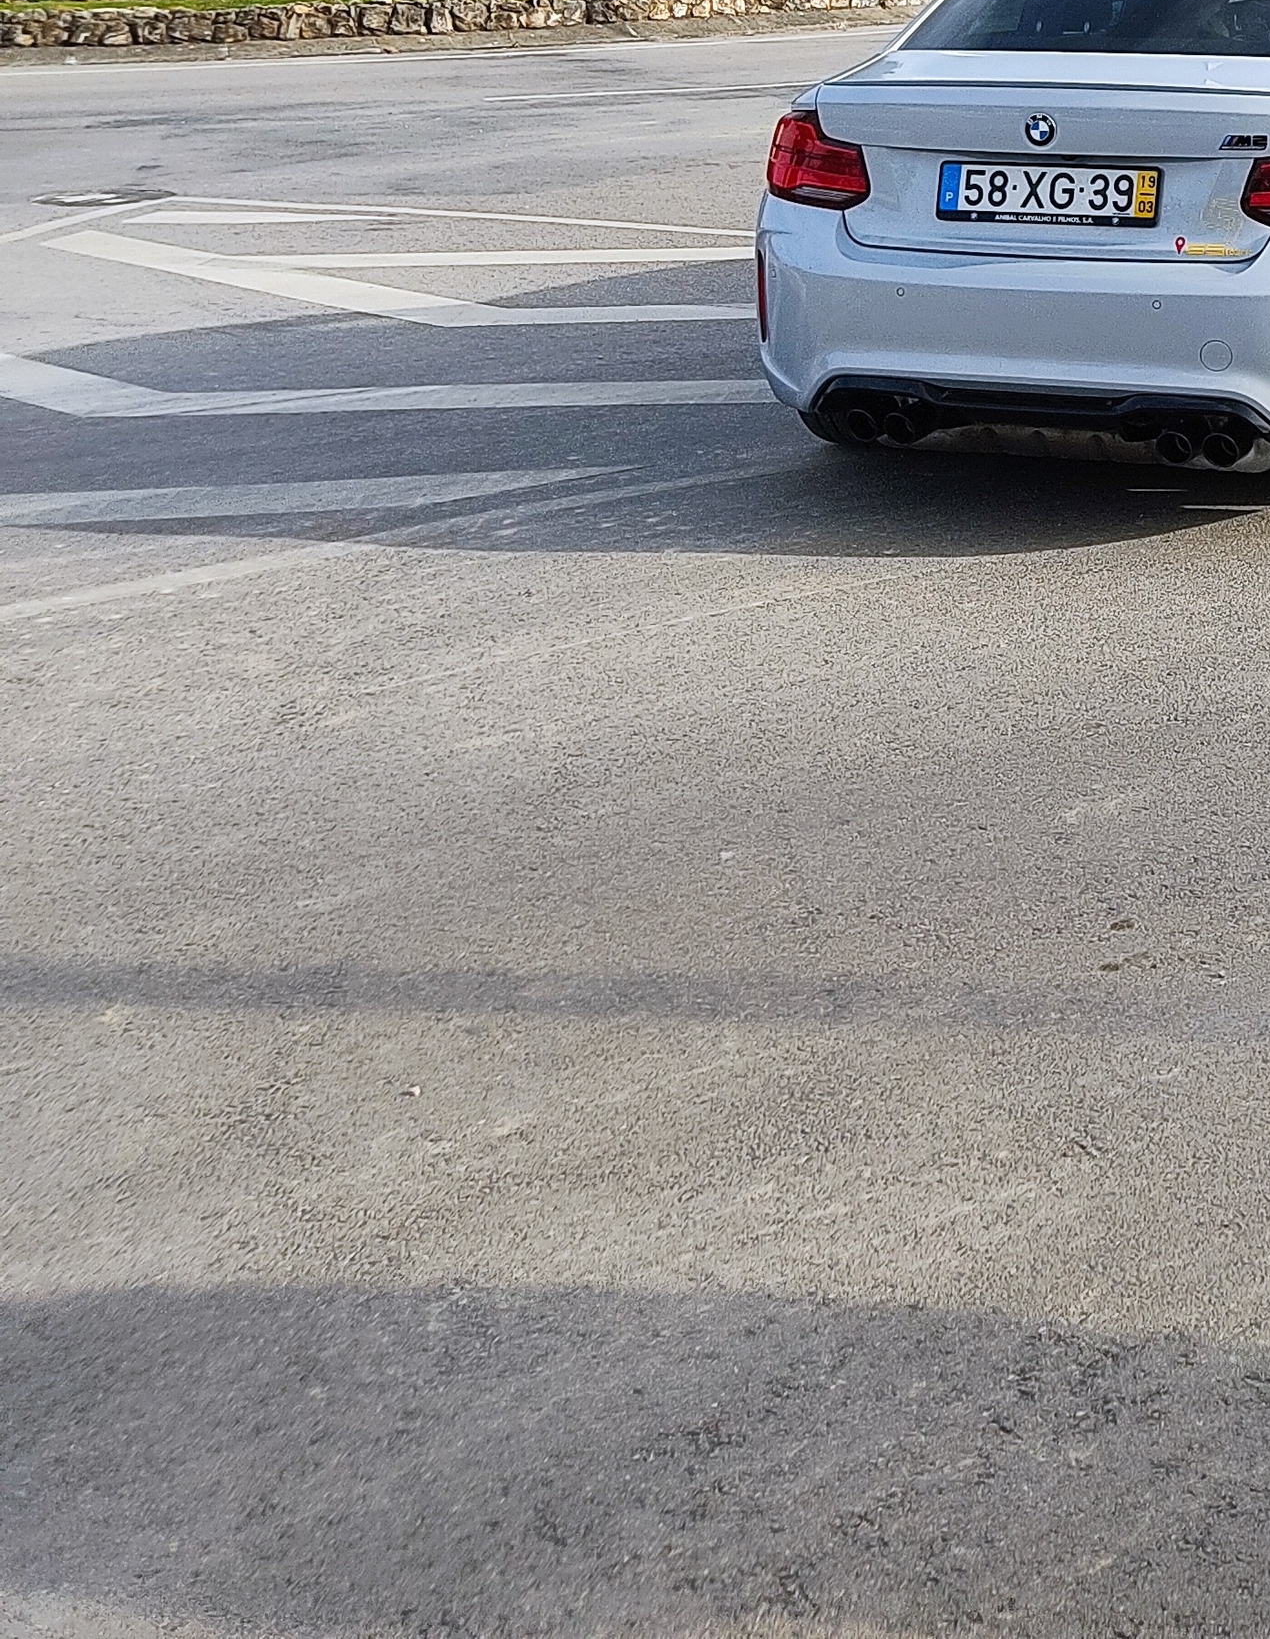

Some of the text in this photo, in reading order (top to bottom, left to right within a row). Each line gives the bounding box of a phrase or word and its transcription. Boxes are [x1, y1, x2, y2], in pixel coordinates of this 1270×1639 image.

[1140, 175, 1156, 189] 19
[945, 191, 954, 203] P
[1138, 201, 1154, 214] 03
